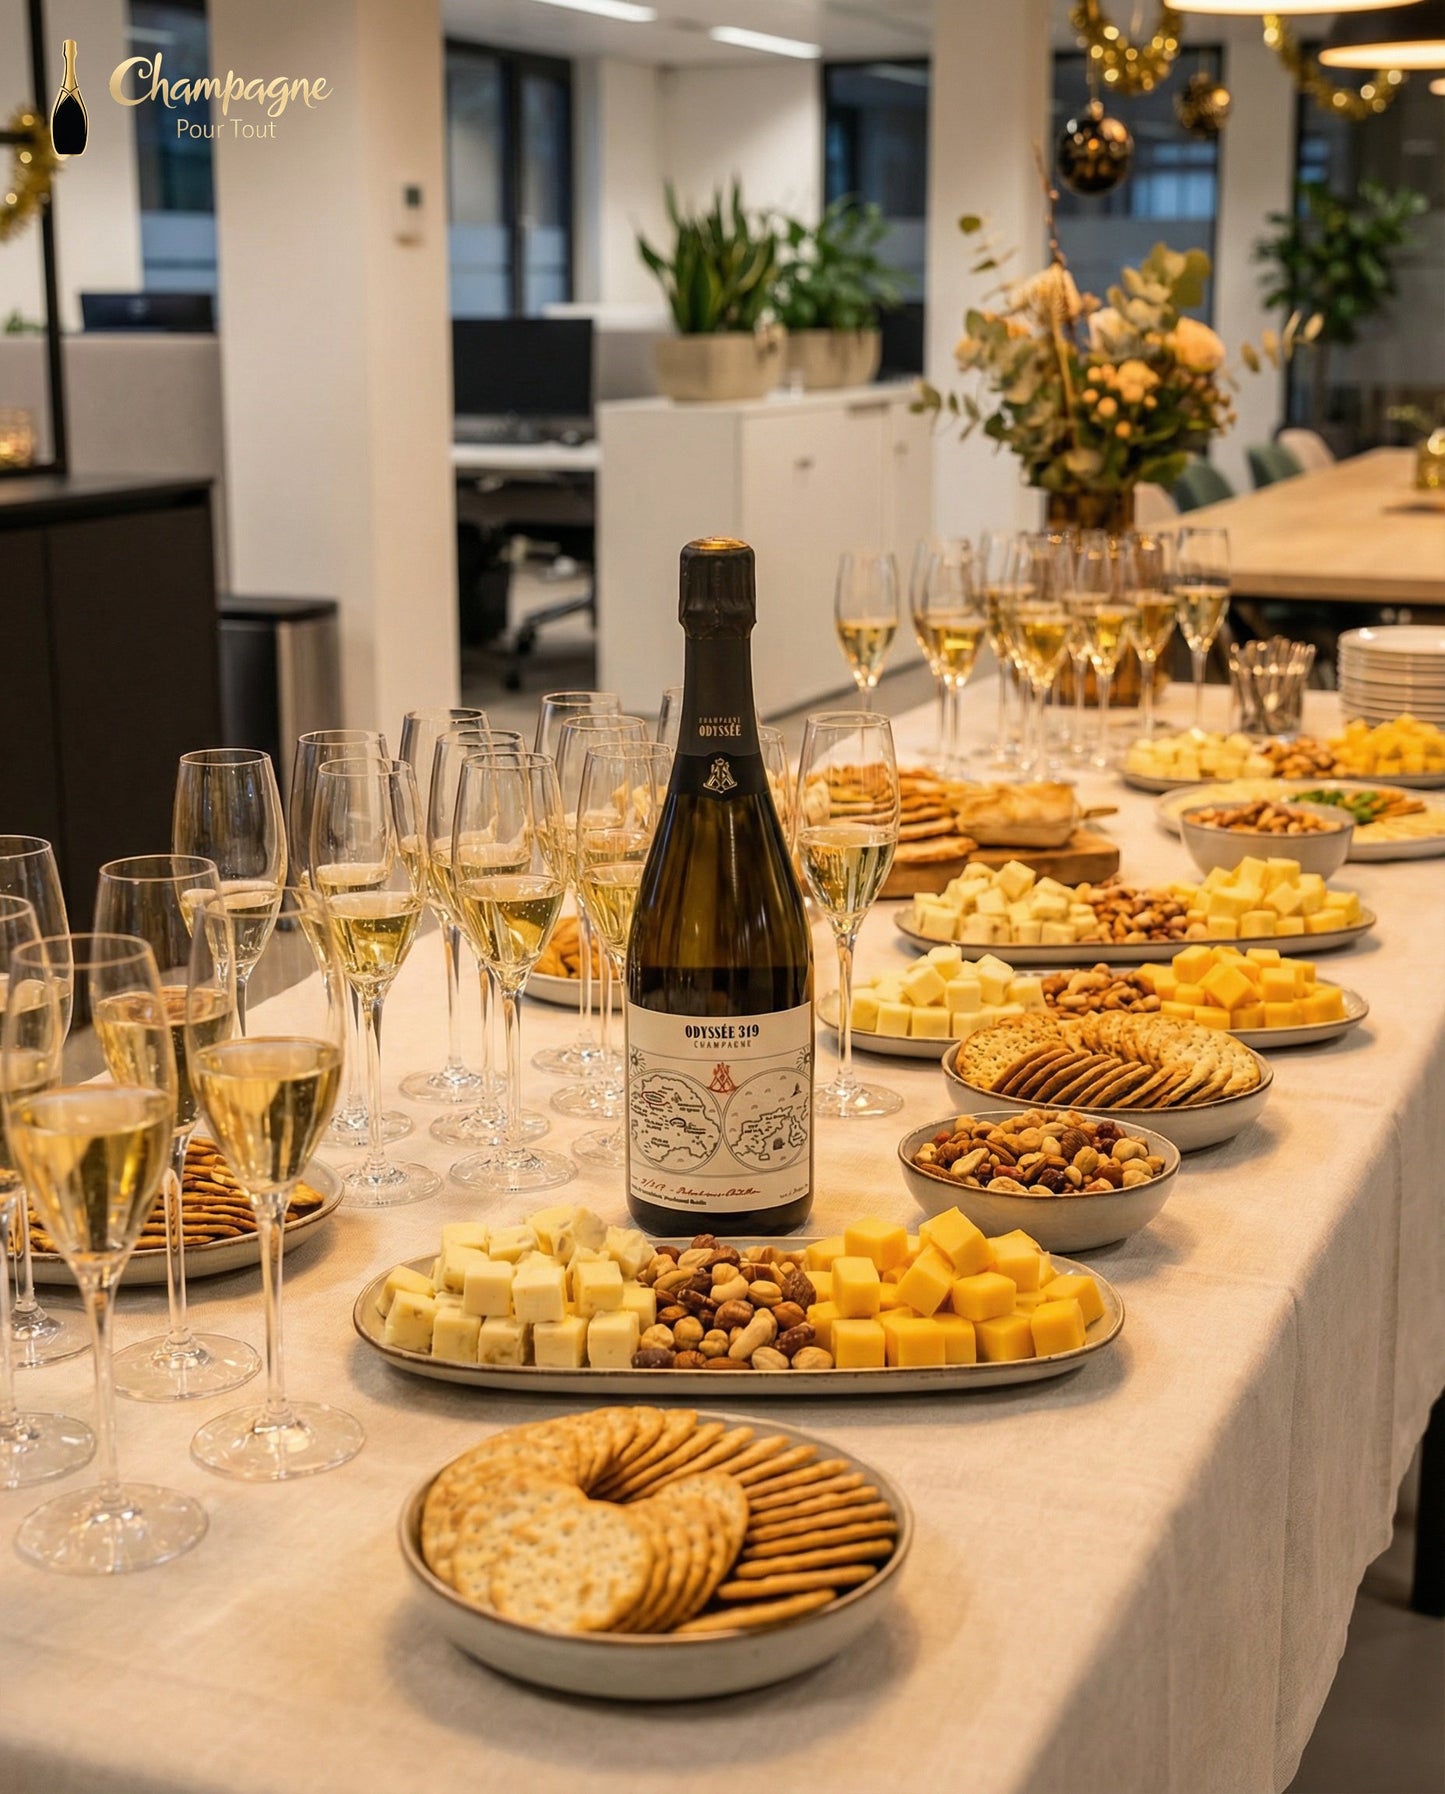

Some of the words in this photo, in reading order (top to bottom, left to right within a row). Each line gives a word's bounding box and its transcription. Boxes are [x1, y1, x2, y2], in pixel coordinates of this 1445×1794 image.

[699, 723, 742, 737] ODYSSÉE
[685, 1023, 735, 1039] ODYSSÉE
[738, 1024, 760, 1038] 319
